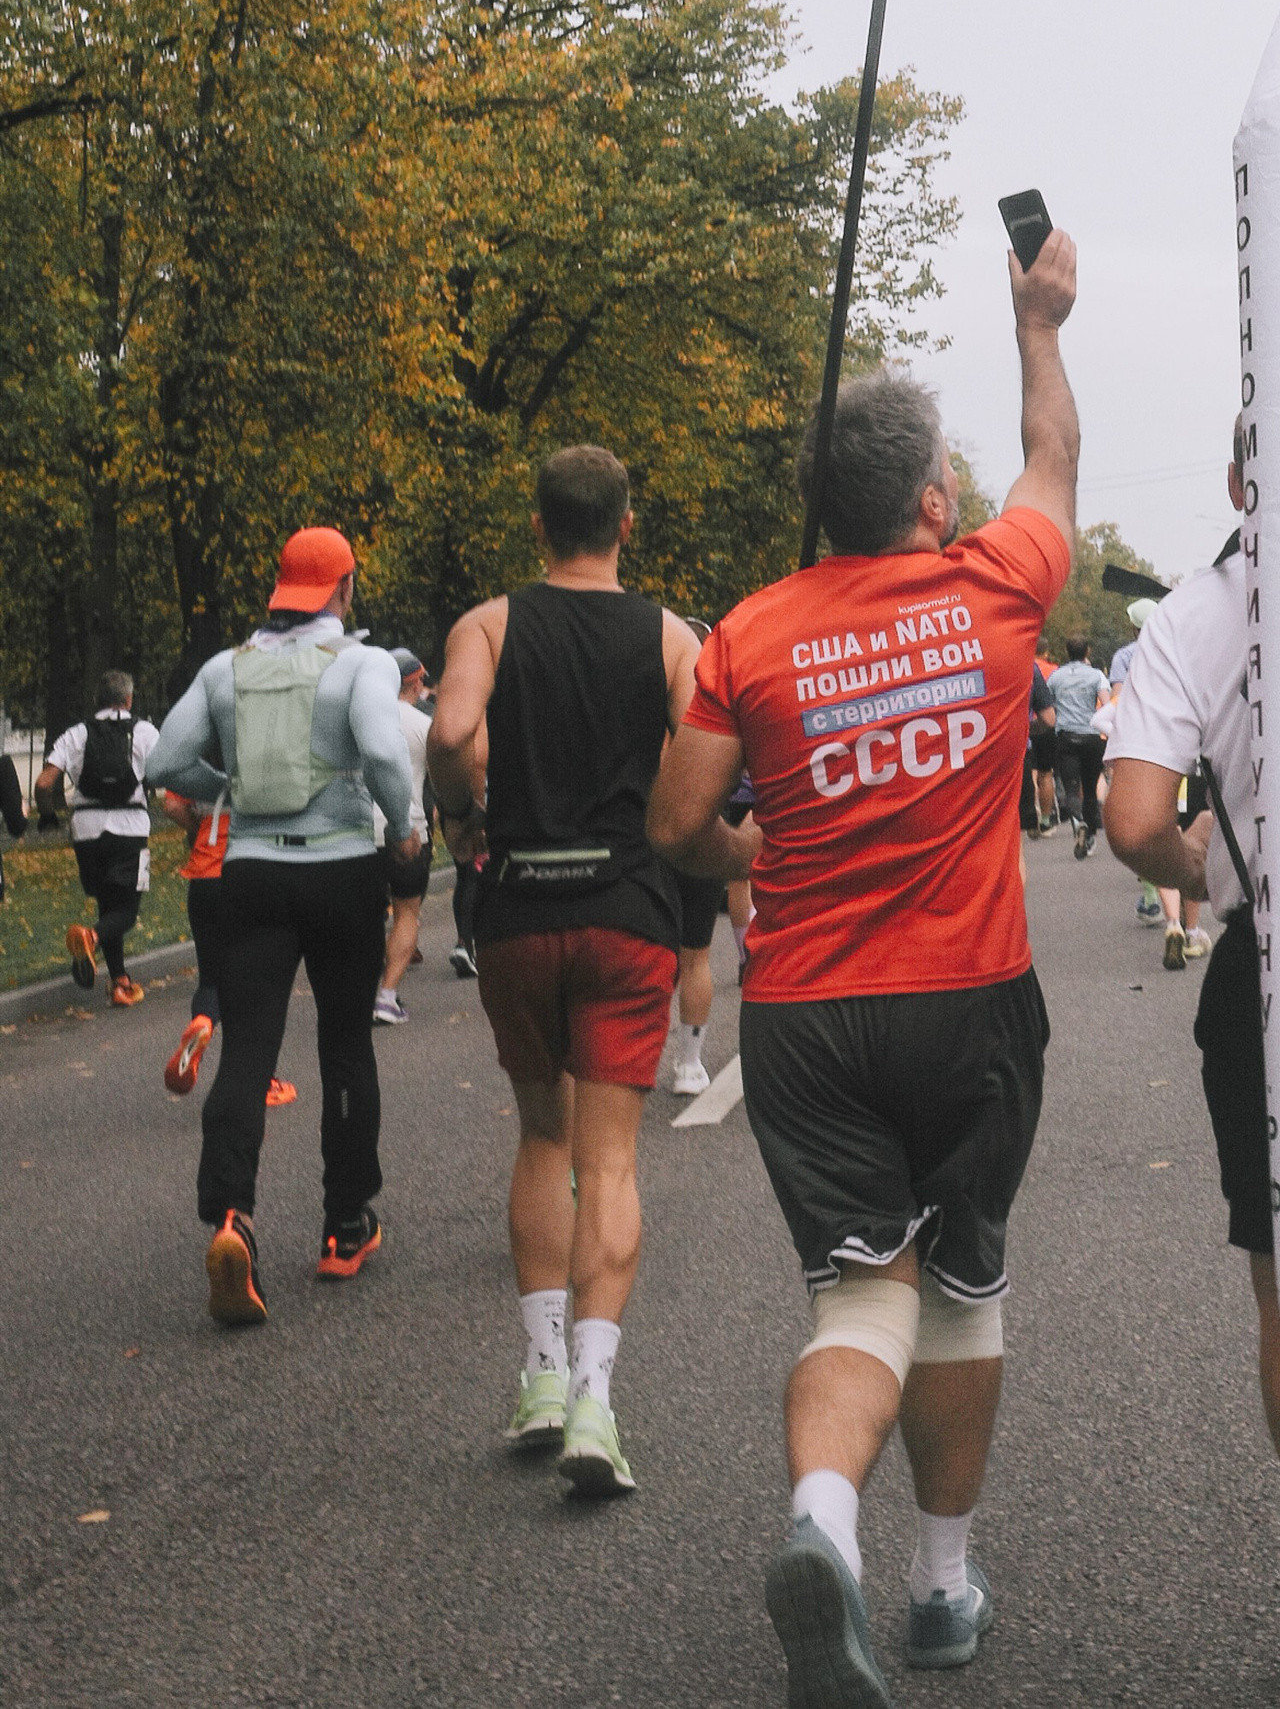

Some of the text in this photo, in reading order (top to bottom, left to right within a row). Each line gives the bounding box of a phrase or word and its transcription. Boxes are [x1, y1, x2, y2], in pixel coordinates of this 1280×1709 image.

[898, 593, 961, 615] kupisarmat.ru
[791, 605, 972, 669] США и NATO
[795, 638, 984, 702] ПОШЛИ ВОН
[811, 677, 977, 731] с территории
[809, 710, 987, 797] СССР
